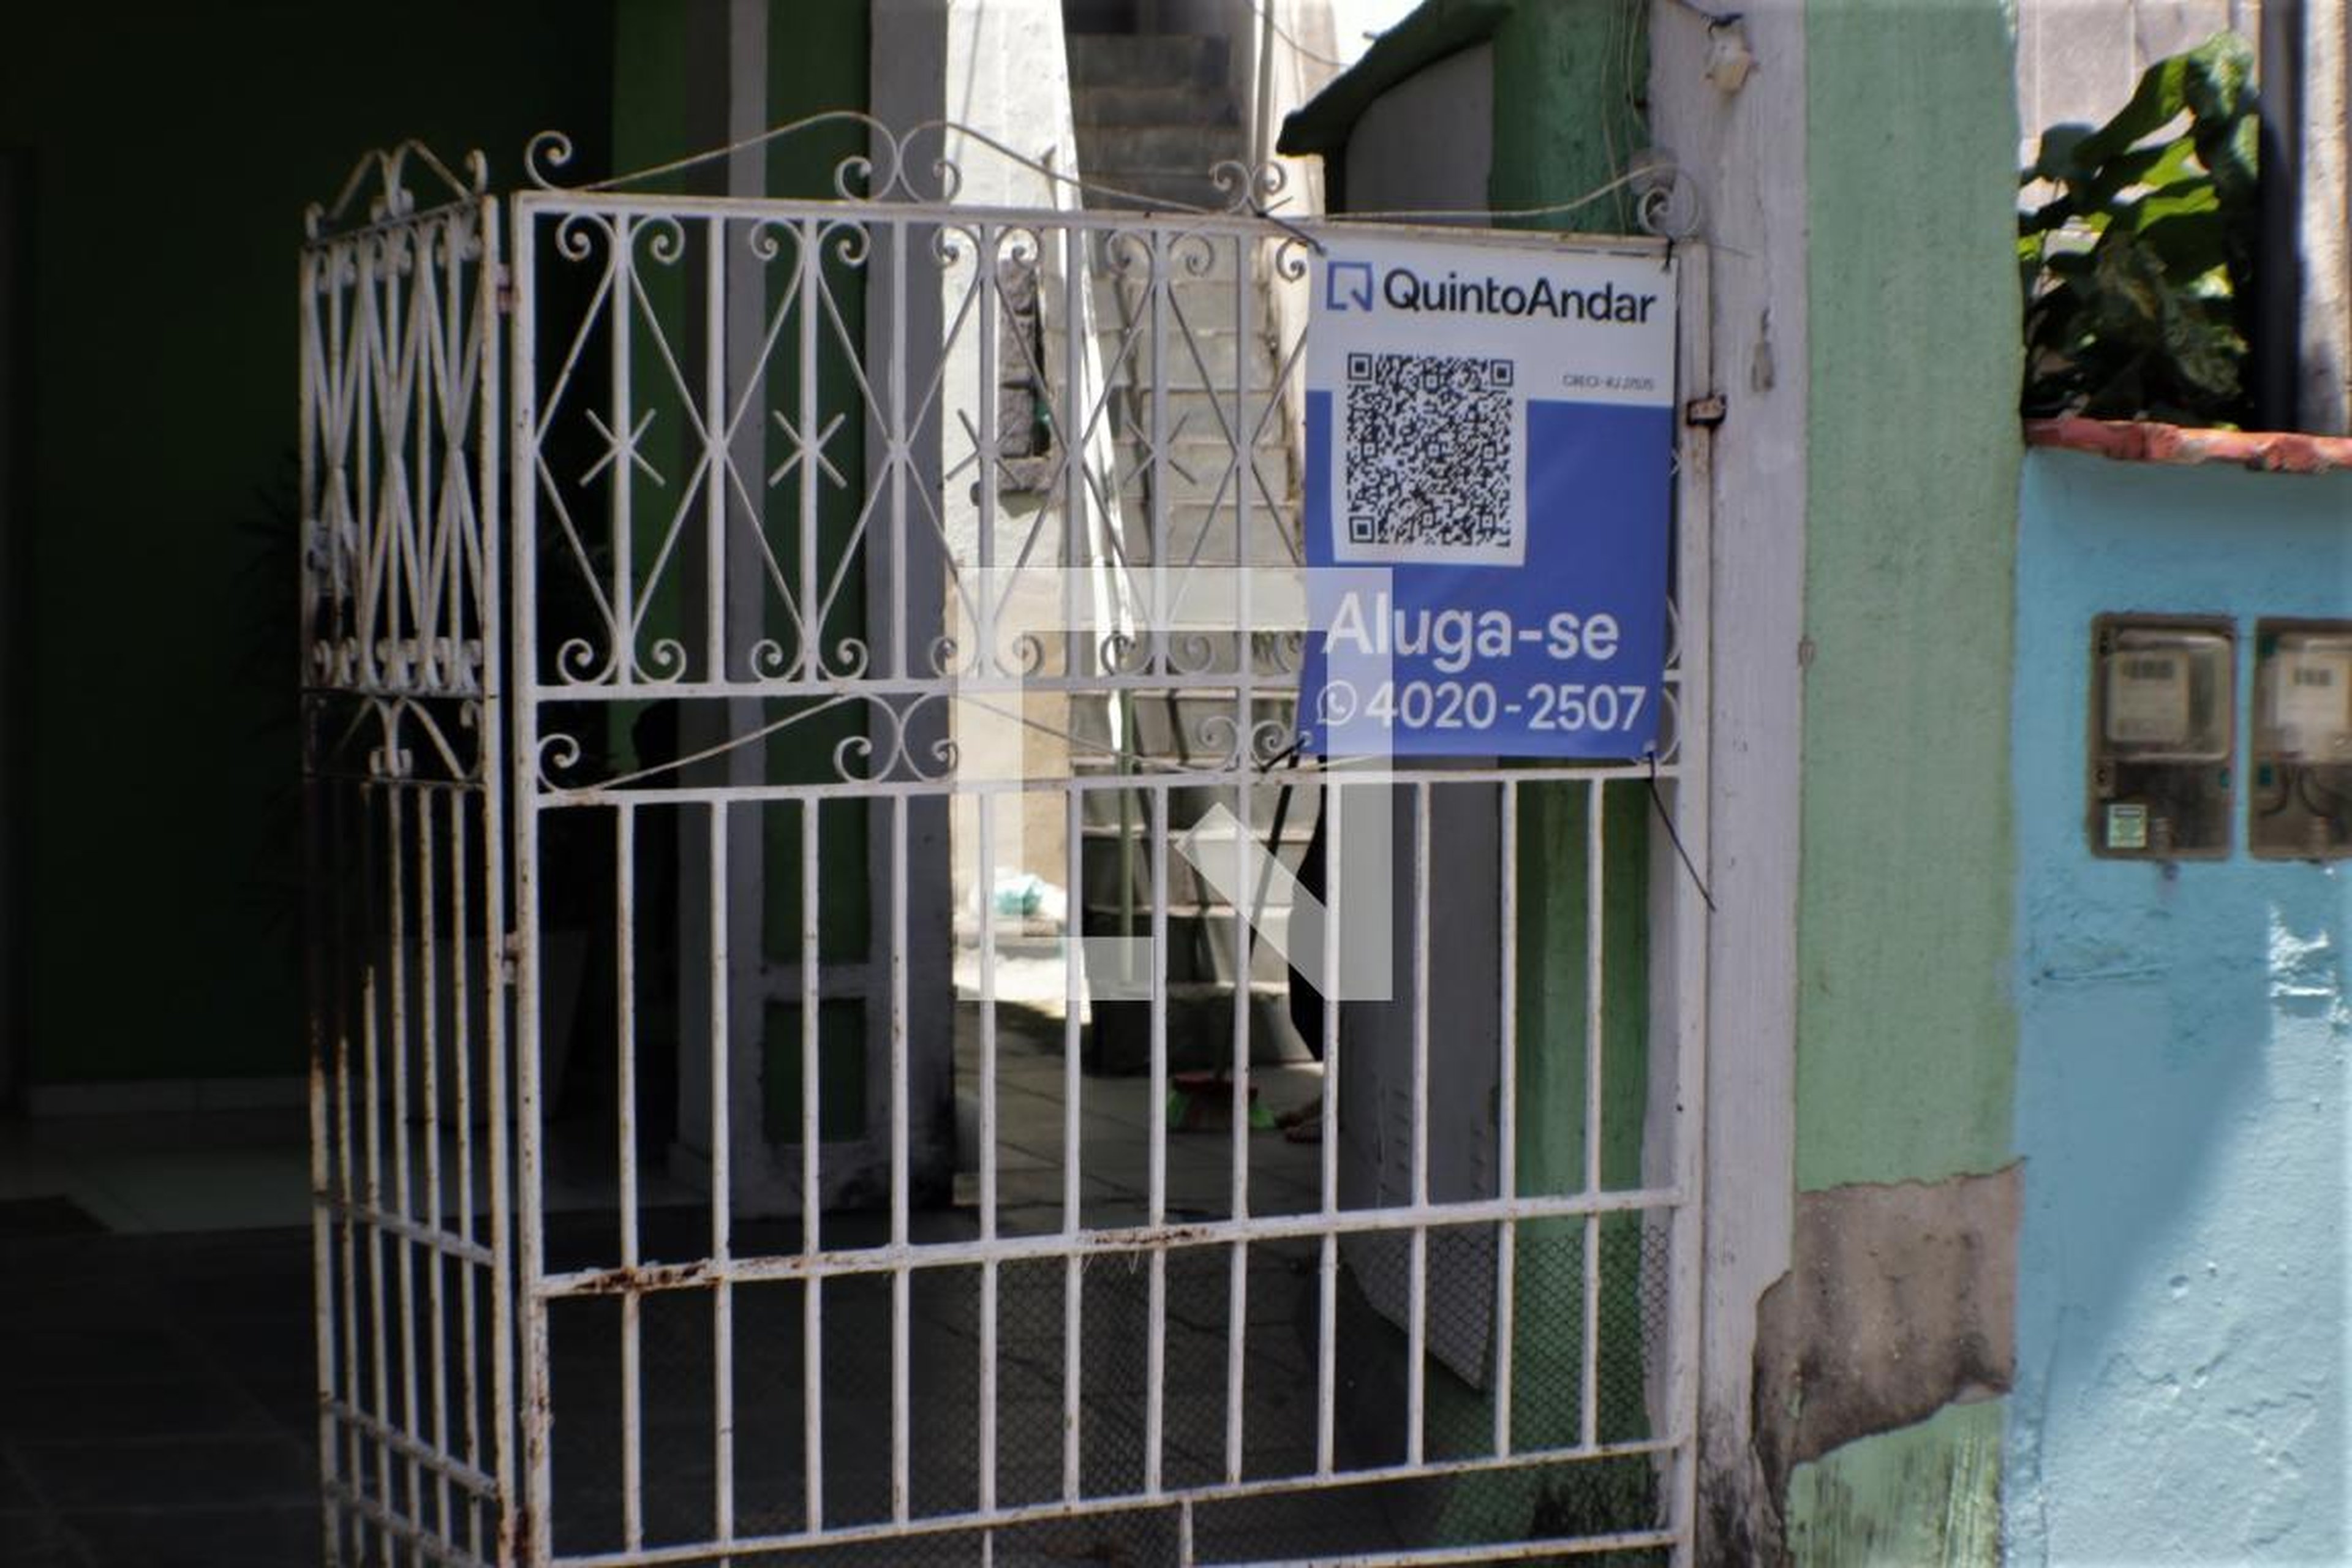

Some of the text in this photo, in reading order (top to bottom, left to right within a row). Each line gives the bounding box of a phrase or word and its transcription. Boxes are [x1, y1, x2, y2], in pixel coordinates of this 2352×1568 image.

[1383, 268, 1657, 323] QuintoAndar
[1322, 592, 1619, 673] Aluga-se
[1365, 680, 1646, 731] 4020-2507
